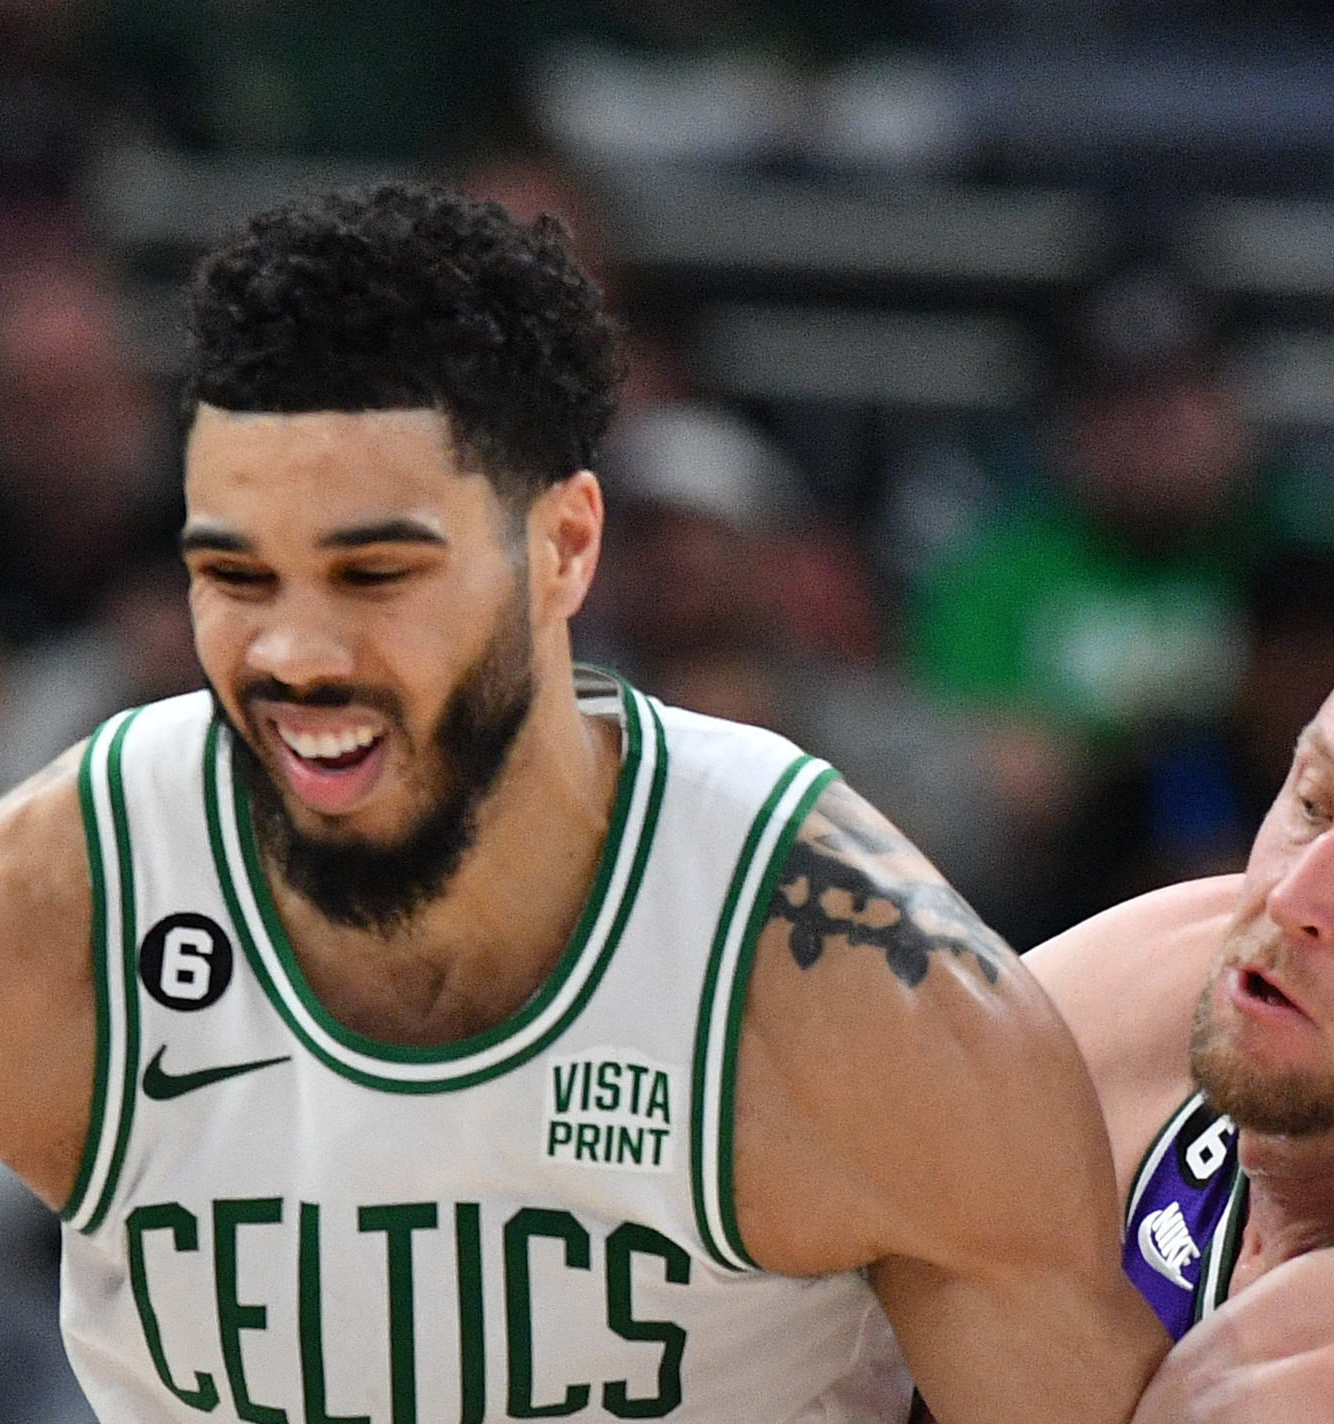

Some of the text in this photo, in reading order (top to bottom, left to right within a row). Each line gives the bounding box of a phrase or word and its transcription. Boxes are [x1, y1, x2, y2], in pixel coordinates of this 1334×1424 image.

[158, 925, 215, 1001] 6
[553, 1061, 670, 1125] VISTA
[547, 1120, 670, 1166] PRINT
[1185, 1114, 1236, 1180] 6
